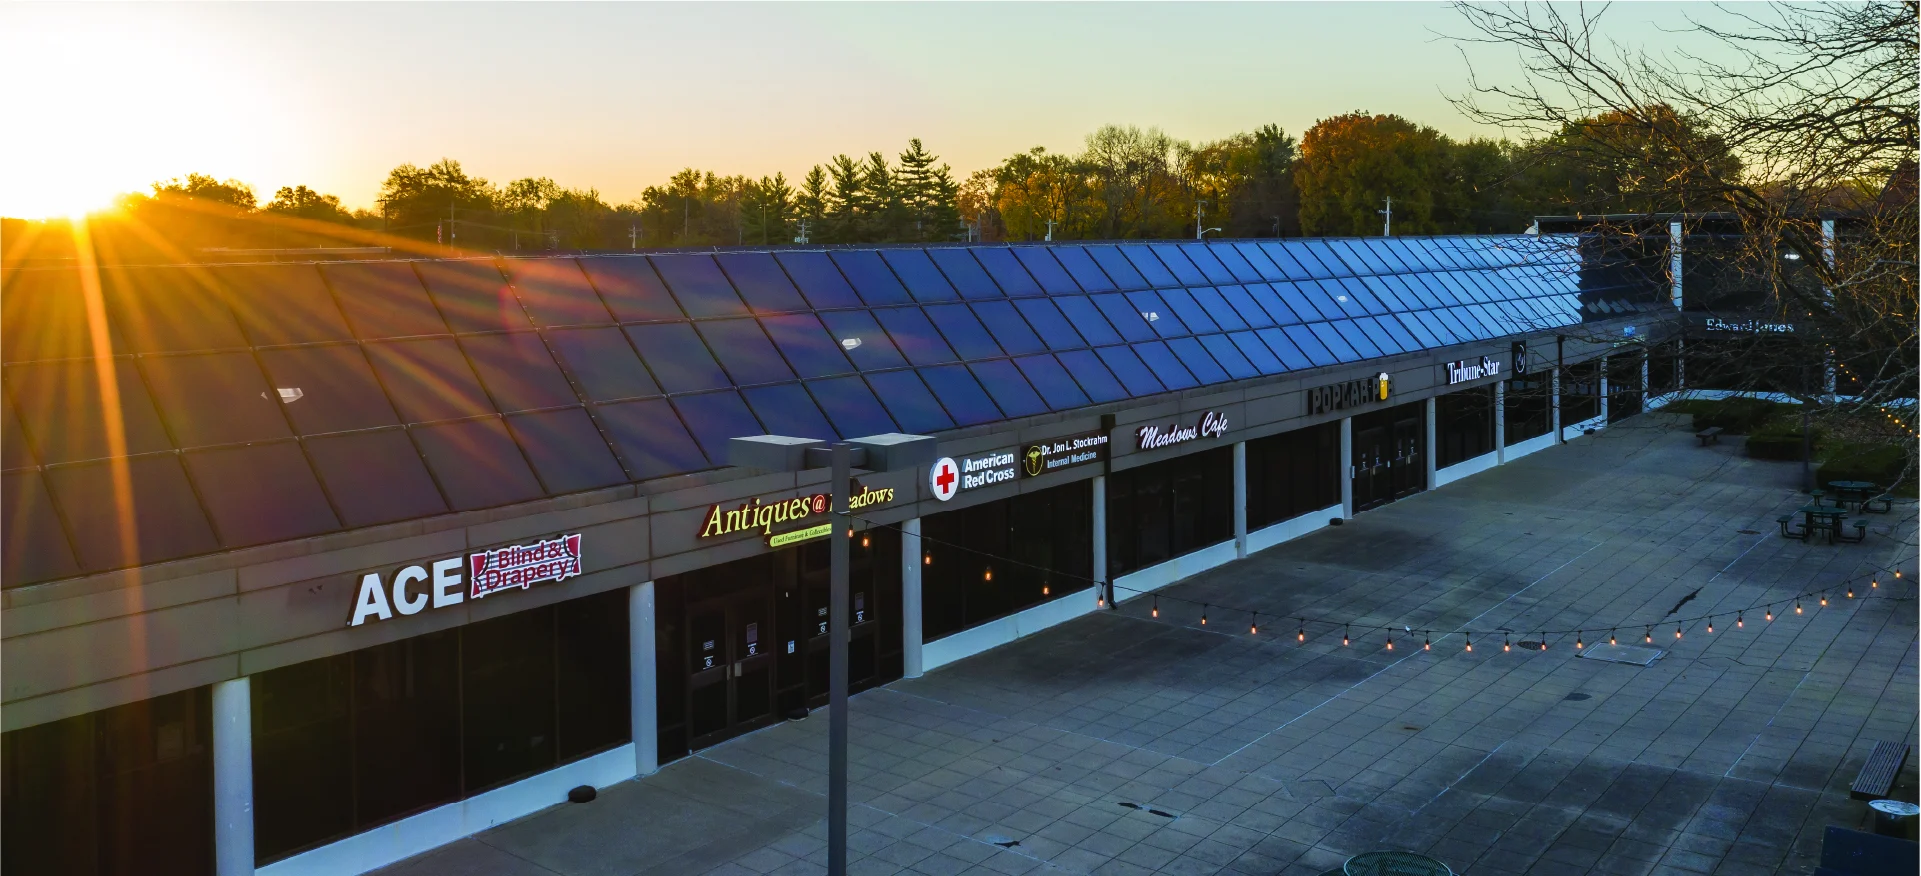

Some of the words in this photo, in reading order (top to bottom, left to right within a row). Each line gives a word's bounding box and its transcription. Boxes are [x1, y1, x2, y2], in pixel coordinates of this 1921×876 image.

[1447, 356, 1500, 385] Tribune-Star
[1140, 424, 1197, 449] Meadows
[1202, 411, 1228, 438] Cafe
[1041, 445, 1052, 456] Dr.
[1052, 443, 1065, 454] Jon
[1065, 440, 1072, 451] L.
[1073, 435, 1108, 450] Stockrahm
[964, 452, 1014, 473] American
[1047, 455, 1070, 469] Internal
[1071, 451, 1097, 464] Medicine
[964, 474, 985, 489] Red
[986, 467, 1015, 485] Cross
[702, 497, 810, 537] Antiques
[828, 486, 894, 513] adows
[498, 542, 545, 569] Blind
[547, 541, 563, 558] &
[485, 558, 569, 588] Drapery
[351, 557, 464, 626] ACE
